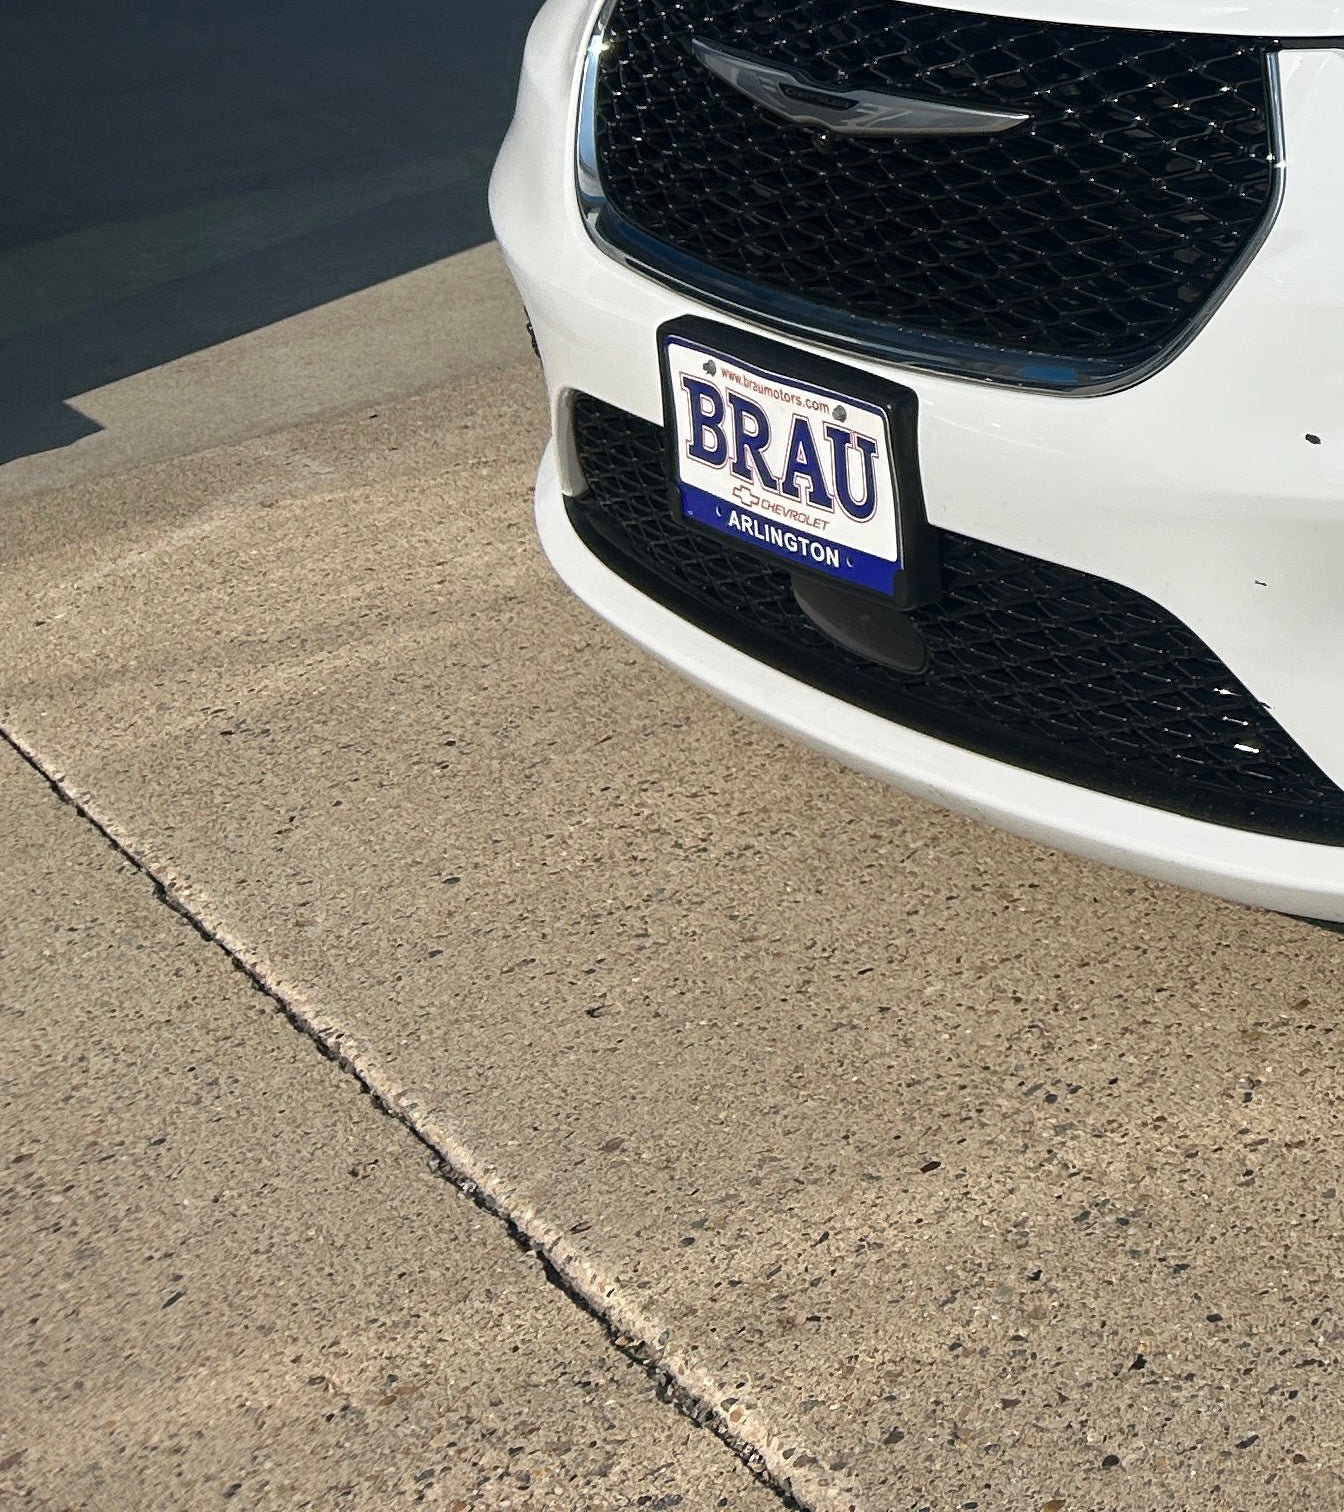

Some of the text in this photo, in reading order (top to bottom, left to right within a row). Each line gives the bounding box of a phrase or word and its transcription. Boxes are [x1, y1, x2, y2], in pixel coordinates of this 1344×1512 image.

[719, 366, 830, 414] www.braumotors.com
[680, 373, 878, 522] BRAU
[728, 510, 841, 568] ARLINGTON
[760, 498, 831, 531] CHEVROLET
